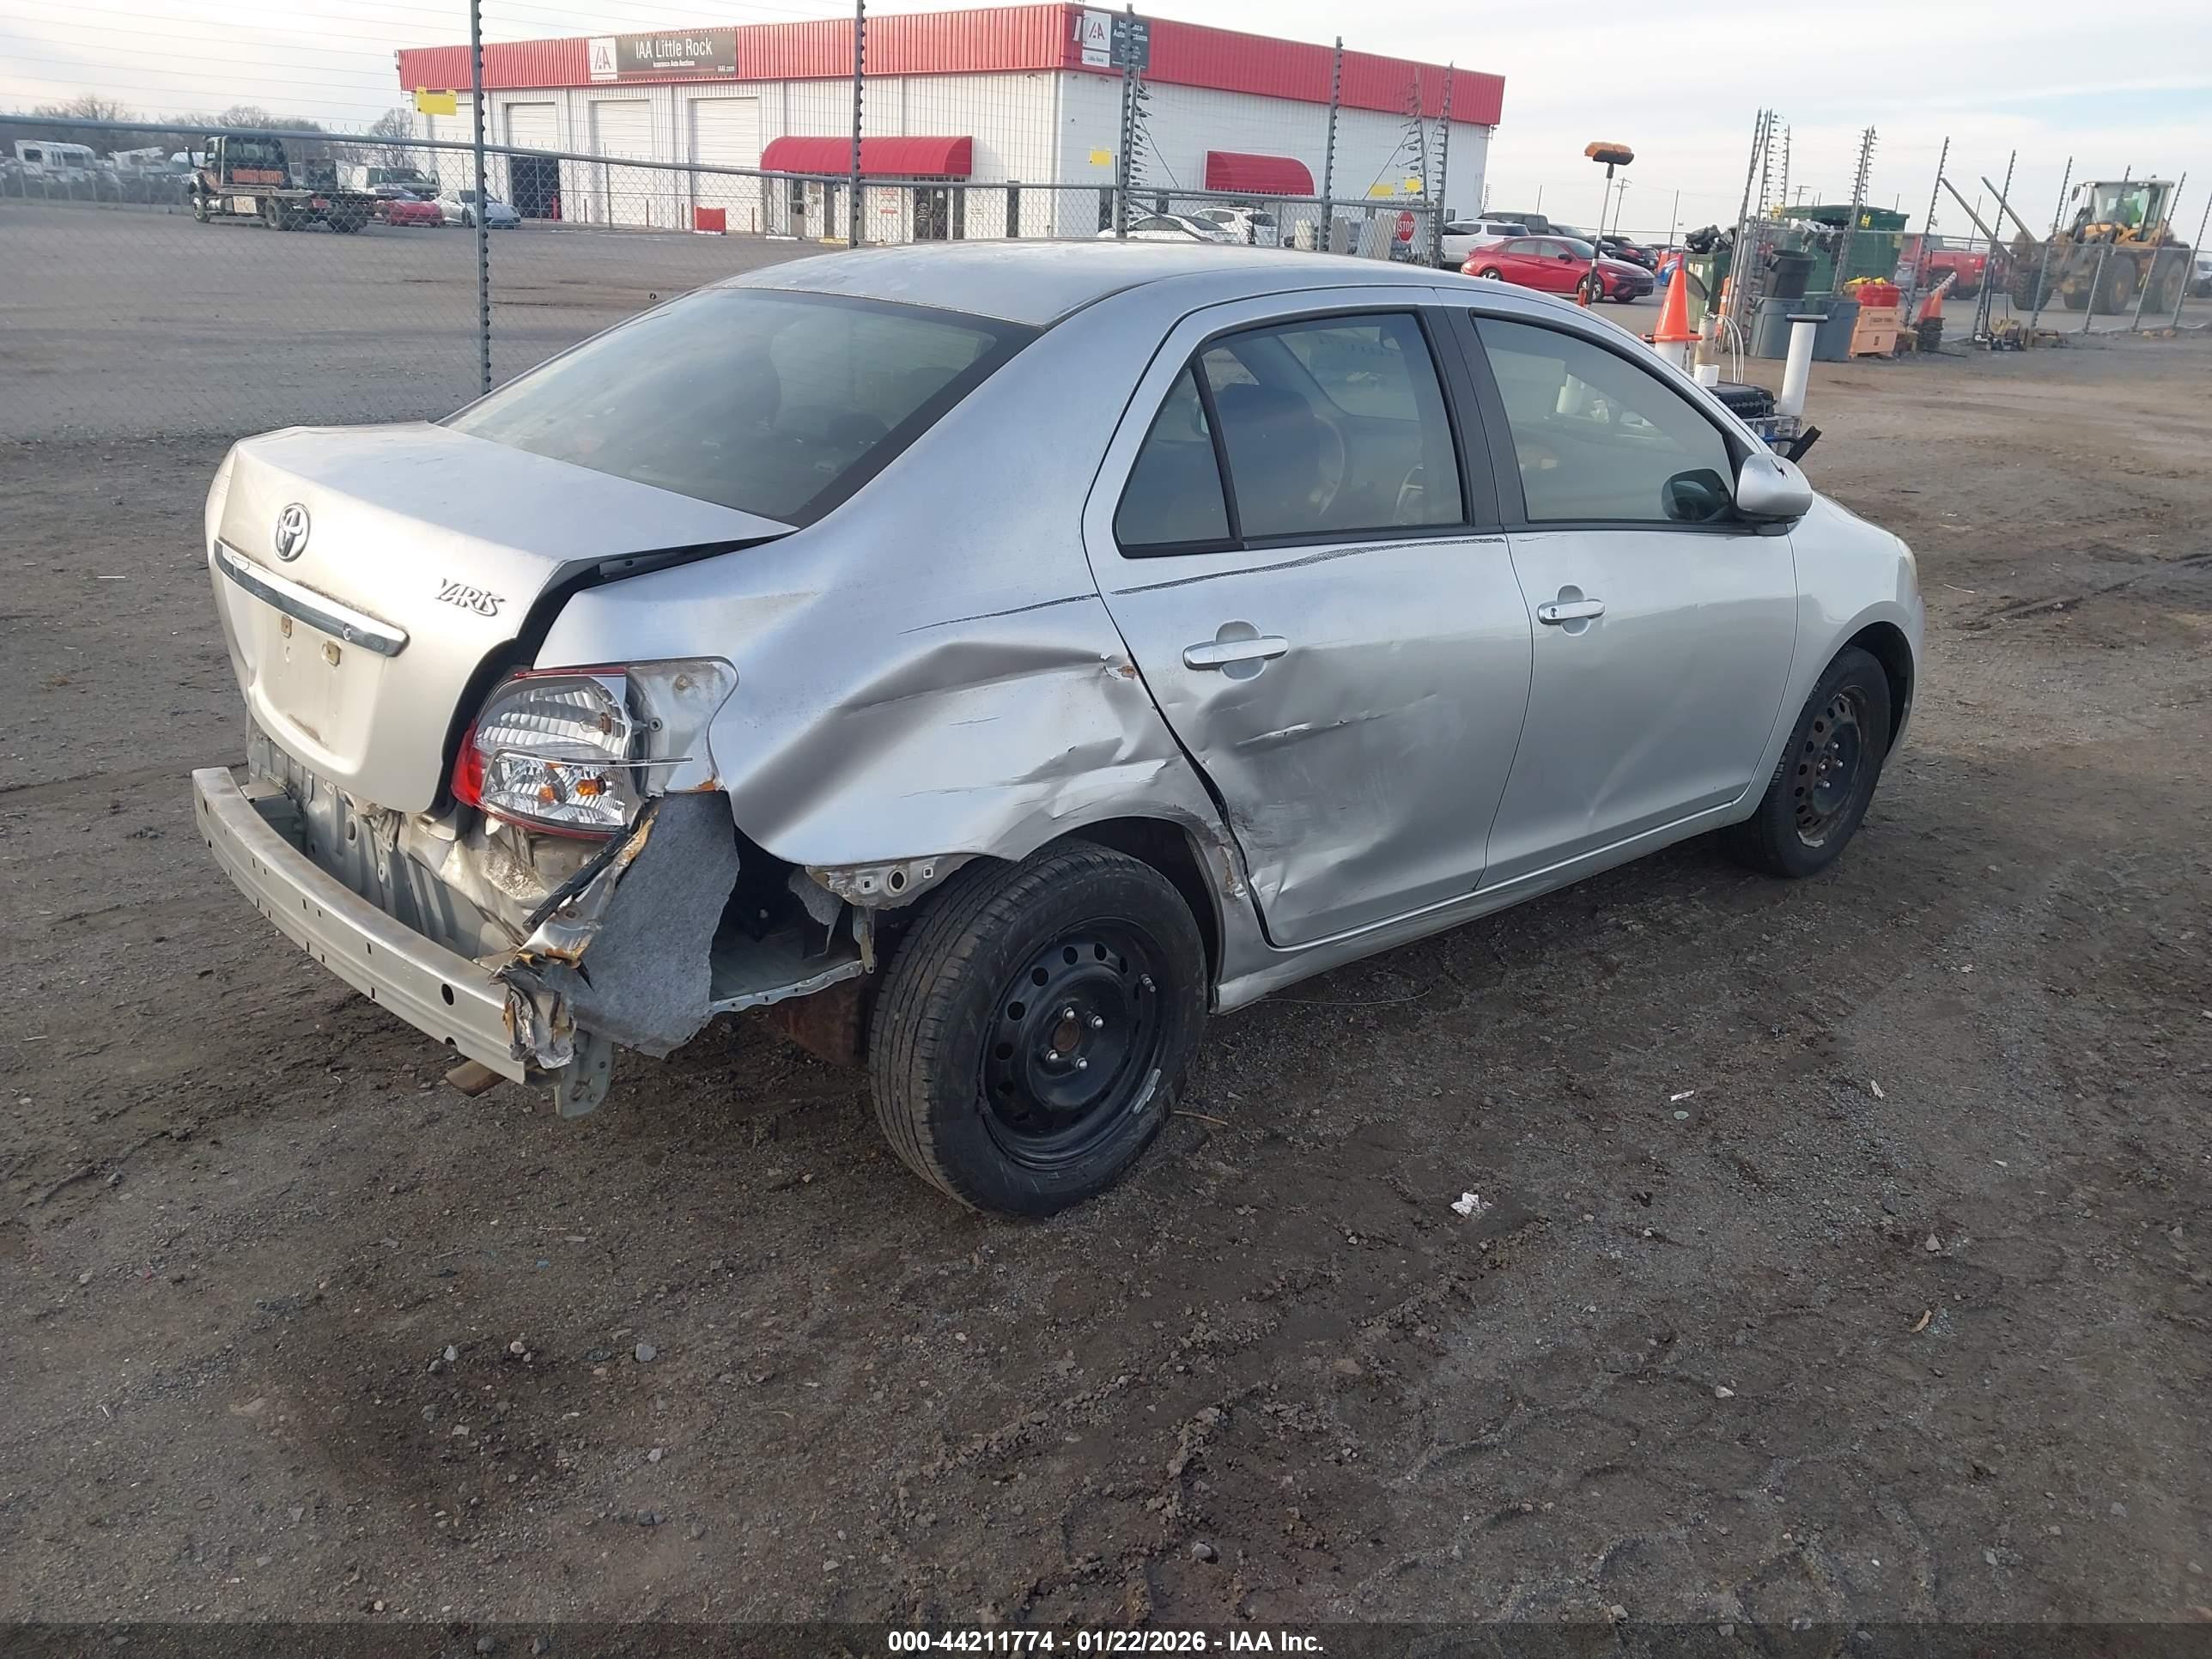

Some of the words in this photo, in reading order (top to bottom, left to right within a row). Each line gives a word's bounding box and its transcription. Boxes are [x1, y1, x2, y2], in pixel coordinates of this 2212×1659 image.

[635, 40, 653, 59] IAA
[655, 39, 682, 58] Little
[685, 37, 713, 57] Rock
[1398, 221, 1414, 233] STOP
[434, 577, 507, 617] YARIS
